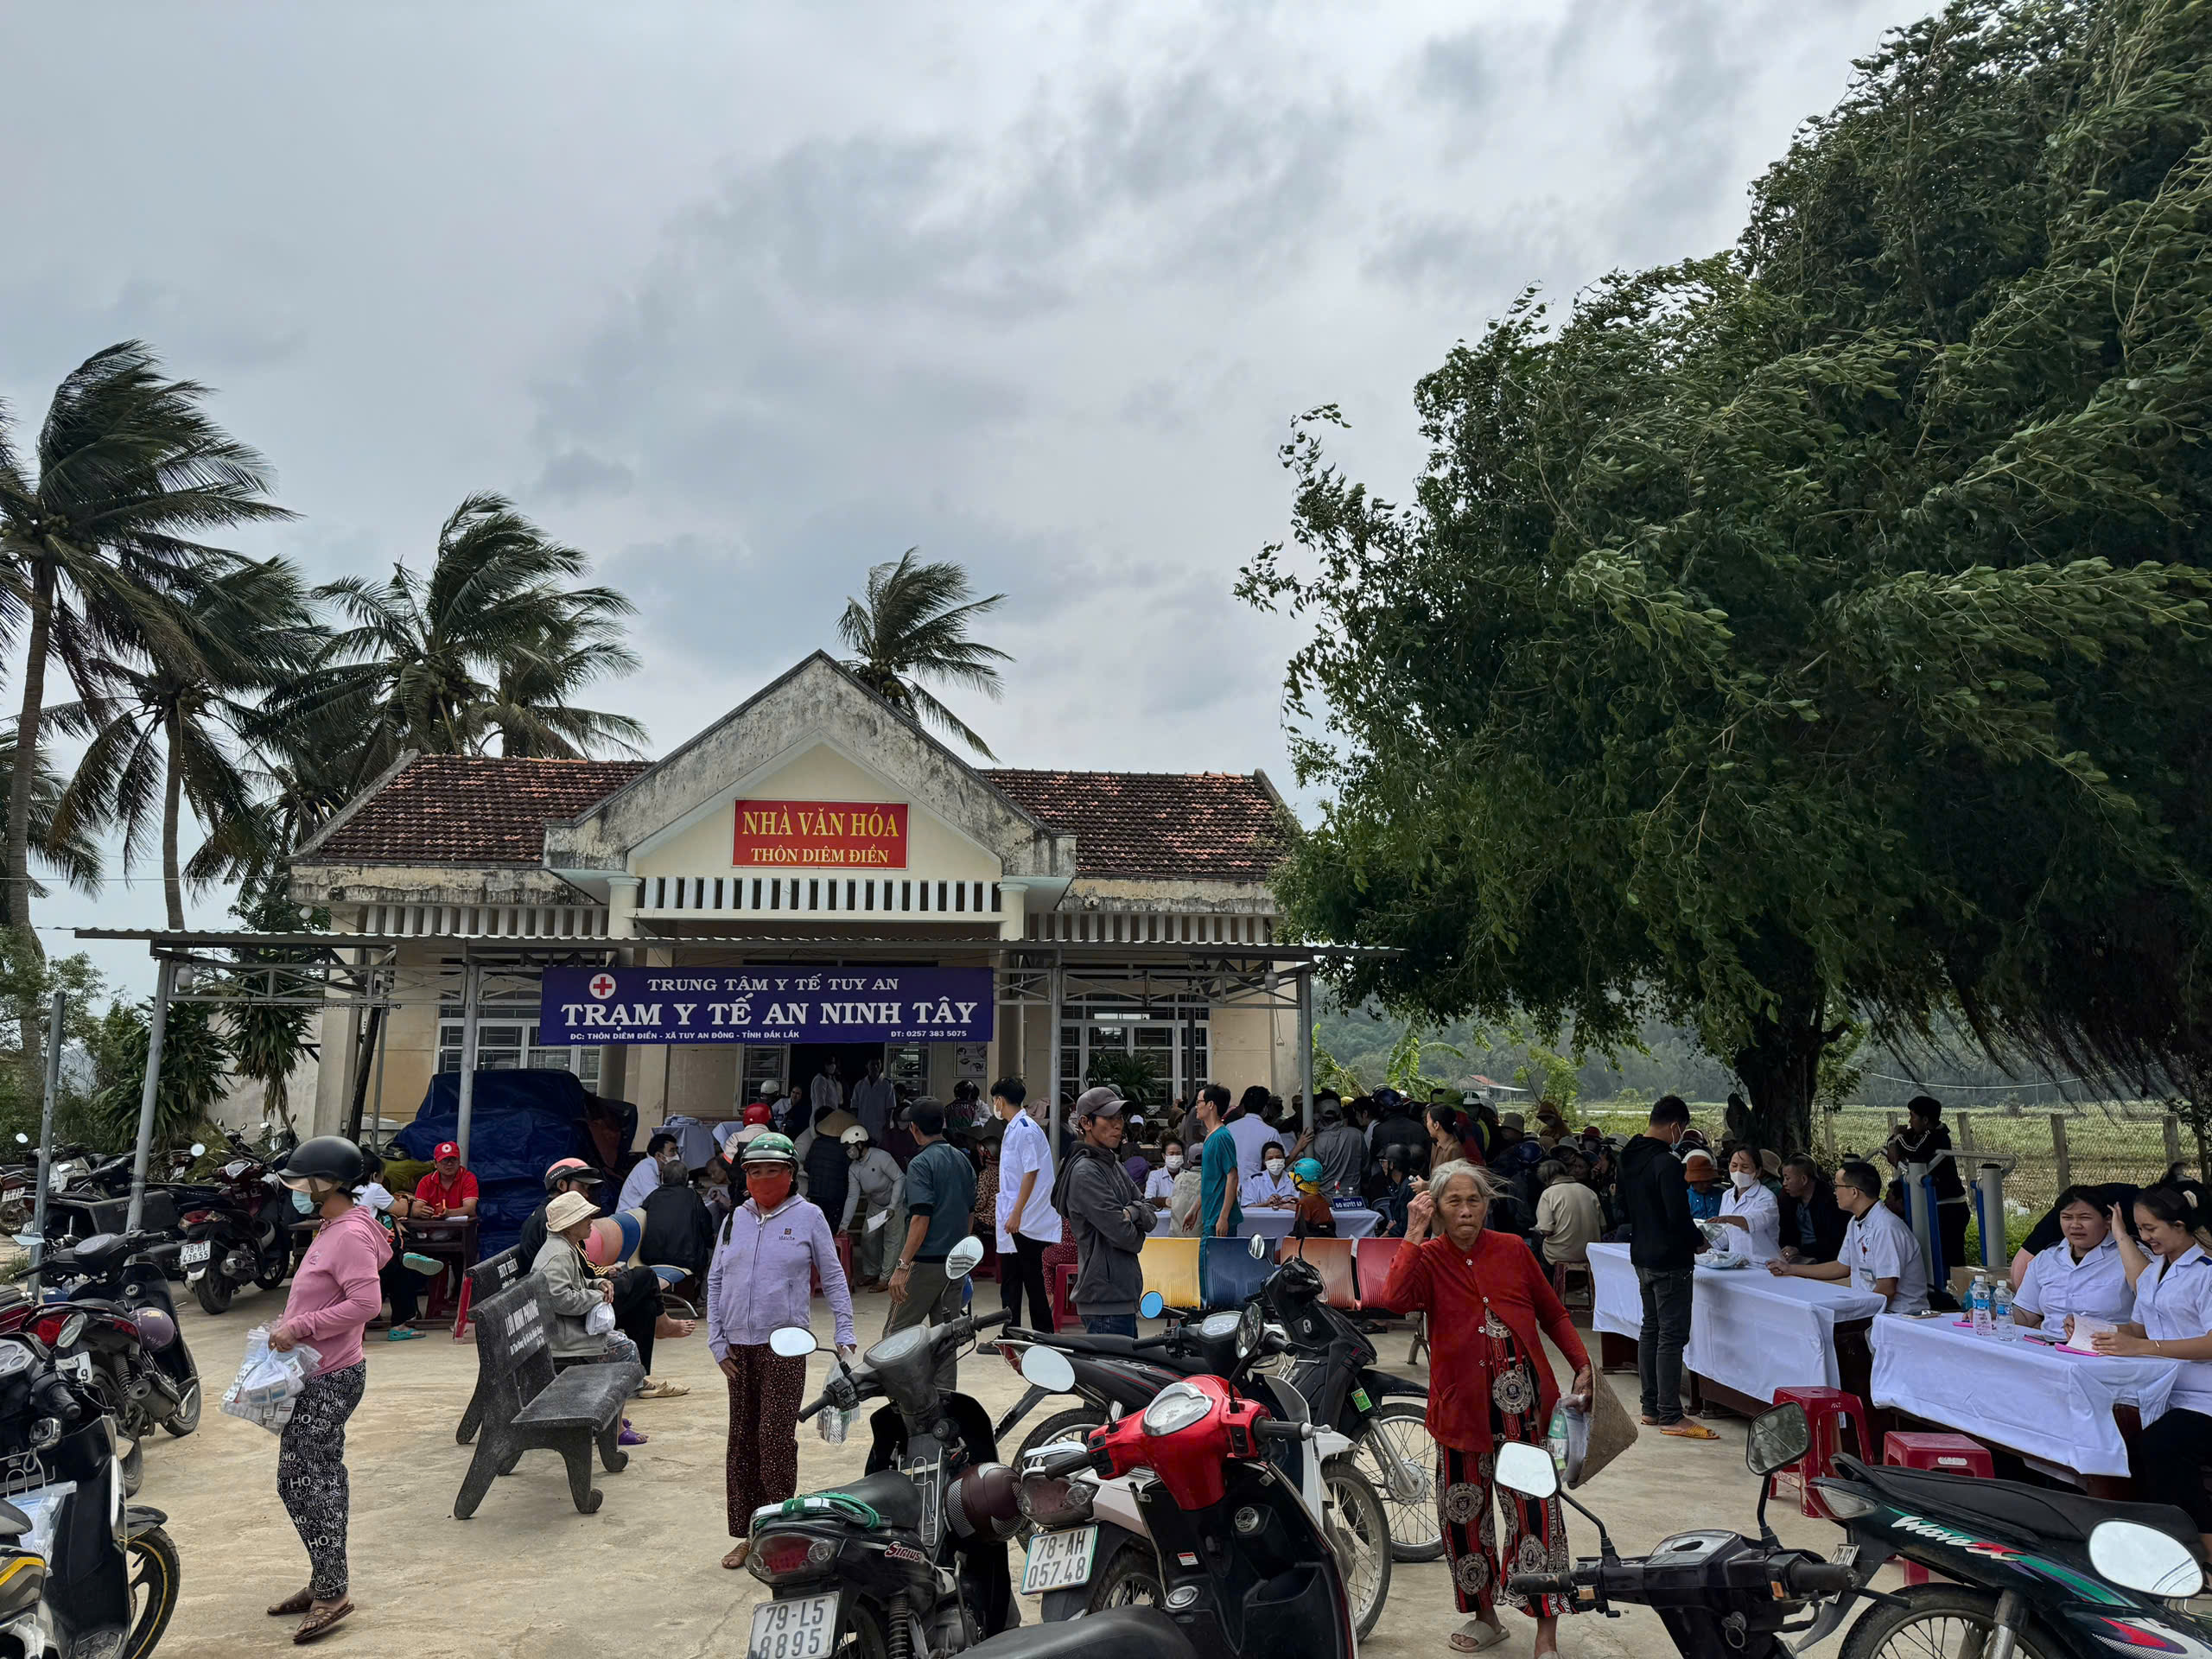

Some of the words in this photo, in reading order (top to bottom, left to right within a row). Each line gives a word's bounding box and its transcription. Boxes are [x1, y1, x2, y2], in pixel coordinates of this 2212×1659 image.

[742, 804, 793, 836] NHÀ
[798, 807, 845, 836] VĂN
[850, 806, 899, 836] HÓA
[751, 844, 798, 861] THÔN
[802, 846, 845, 862] DIÊM
[849, 843, 889, 863] ĐIỀN
[647, 978, 717, 991] TRUNG
[724, 976, 769, 991] TÂM
[775, 978, 789, 990] Y
[795, 973, 822, 990] TẾ
[828, 978, 867, 990] TUY
[872, 978, 899, 990] AN
[561, 1004, 663, 1031] TRẠM
[673, 1003, 697, 1026] Y
[707, 992, 754, 1026] TẾ
[762, 1002, 809, 1026] AN
[820, 1002, 901, 1025] NINH
[912, 995, 978, 1024] TÂY
[588, 1031, 610, 1039] THÔN
[186, 1243, 206, 1254] 78-H1
[1037, 1530, 1086, 1561] 78-AH
[1891, 1516, 1980, 1547] Wave
[1027, 1556, 1086, 1589] 057.48
[765, 1599, 825, 1633] 79-L5
[760, 1628, 822, 1659] 8895
